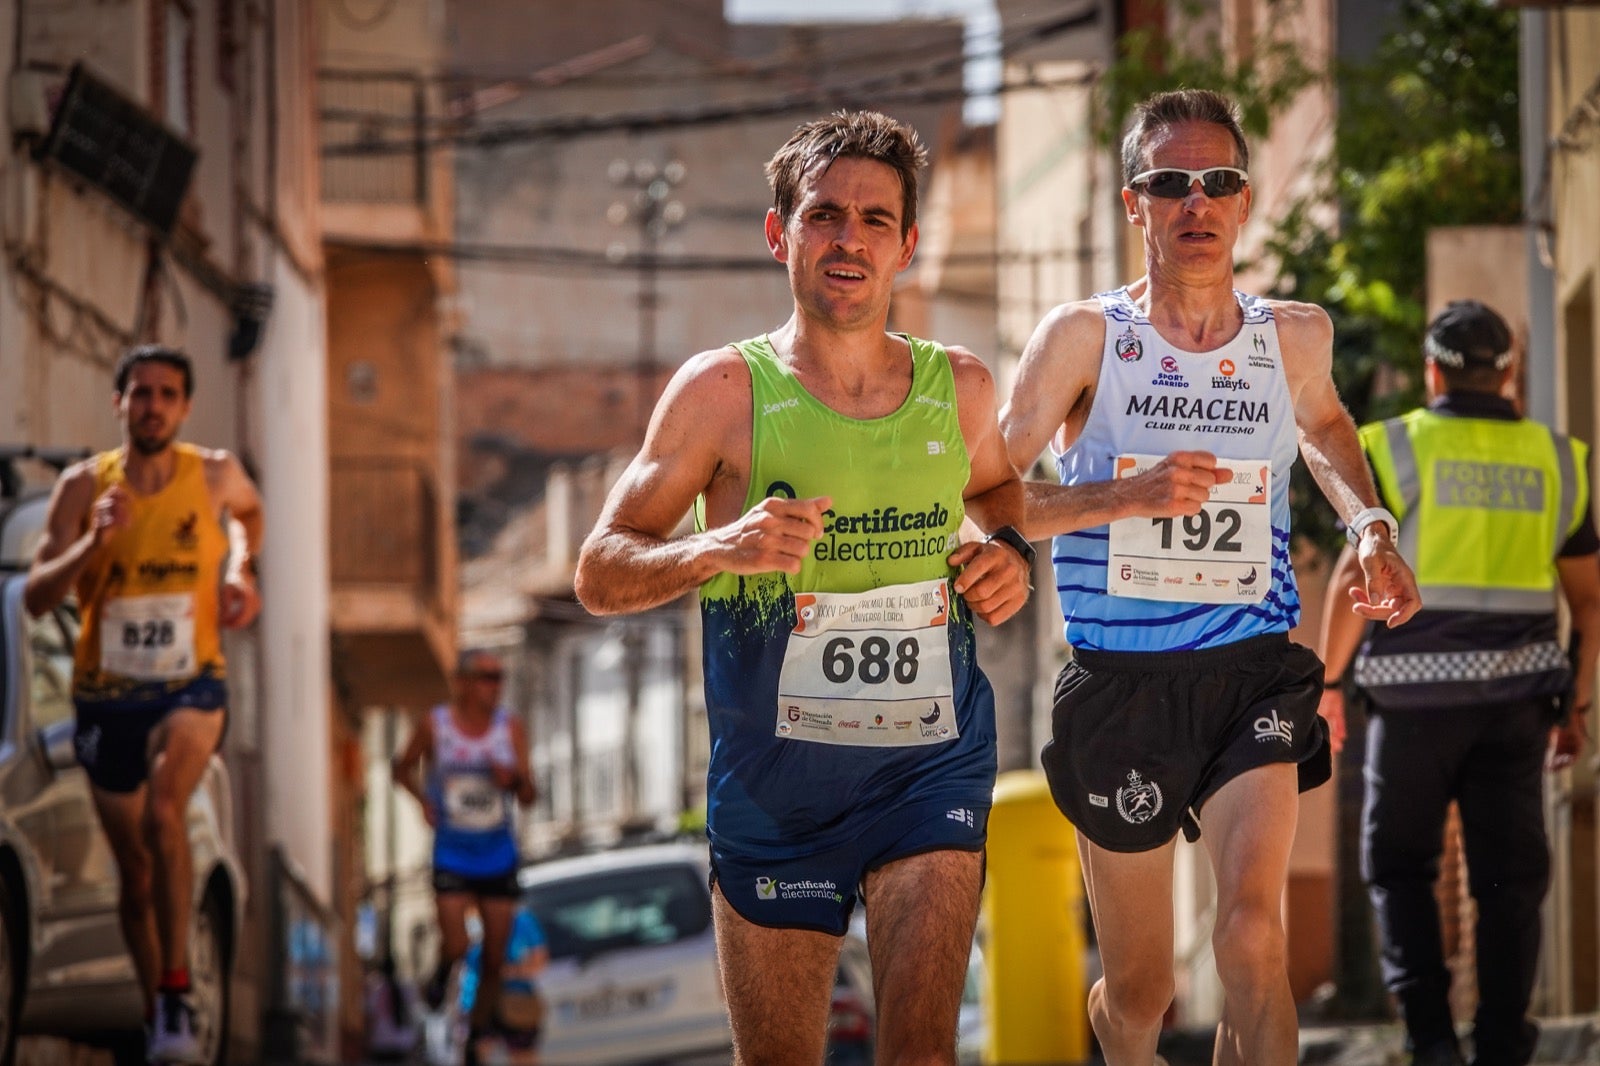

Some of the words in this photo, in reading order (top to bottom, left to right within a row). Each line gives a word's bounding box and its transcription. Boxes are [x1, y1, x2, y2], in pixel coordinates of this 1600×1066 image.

[1152, 379, 1189, 388] GARRIDO
[1158, 373, 1184, 381] SPORT
[1211, 378, 1250, 392] mayfo
[1125, 394, 1270, 424] MARACENA
[1144, 420, 1176, 431] CLUB
[1178, 423, 1192, 432] DE
[1193, 424, 1255, 435] ATLETISMO
[1449, 484, 1527, 507] LOCAL
[821, 502, 948, 534] Certificado
[1152, 509, 1242, 552] 192
[816, 604, 837, 619] XXXV
[886, 596, 896, 609] DE
[883, 610, 904, 623] LORCA
[822, 636, 920, 684] 688
[779, 880, 837, 890] Certificado
